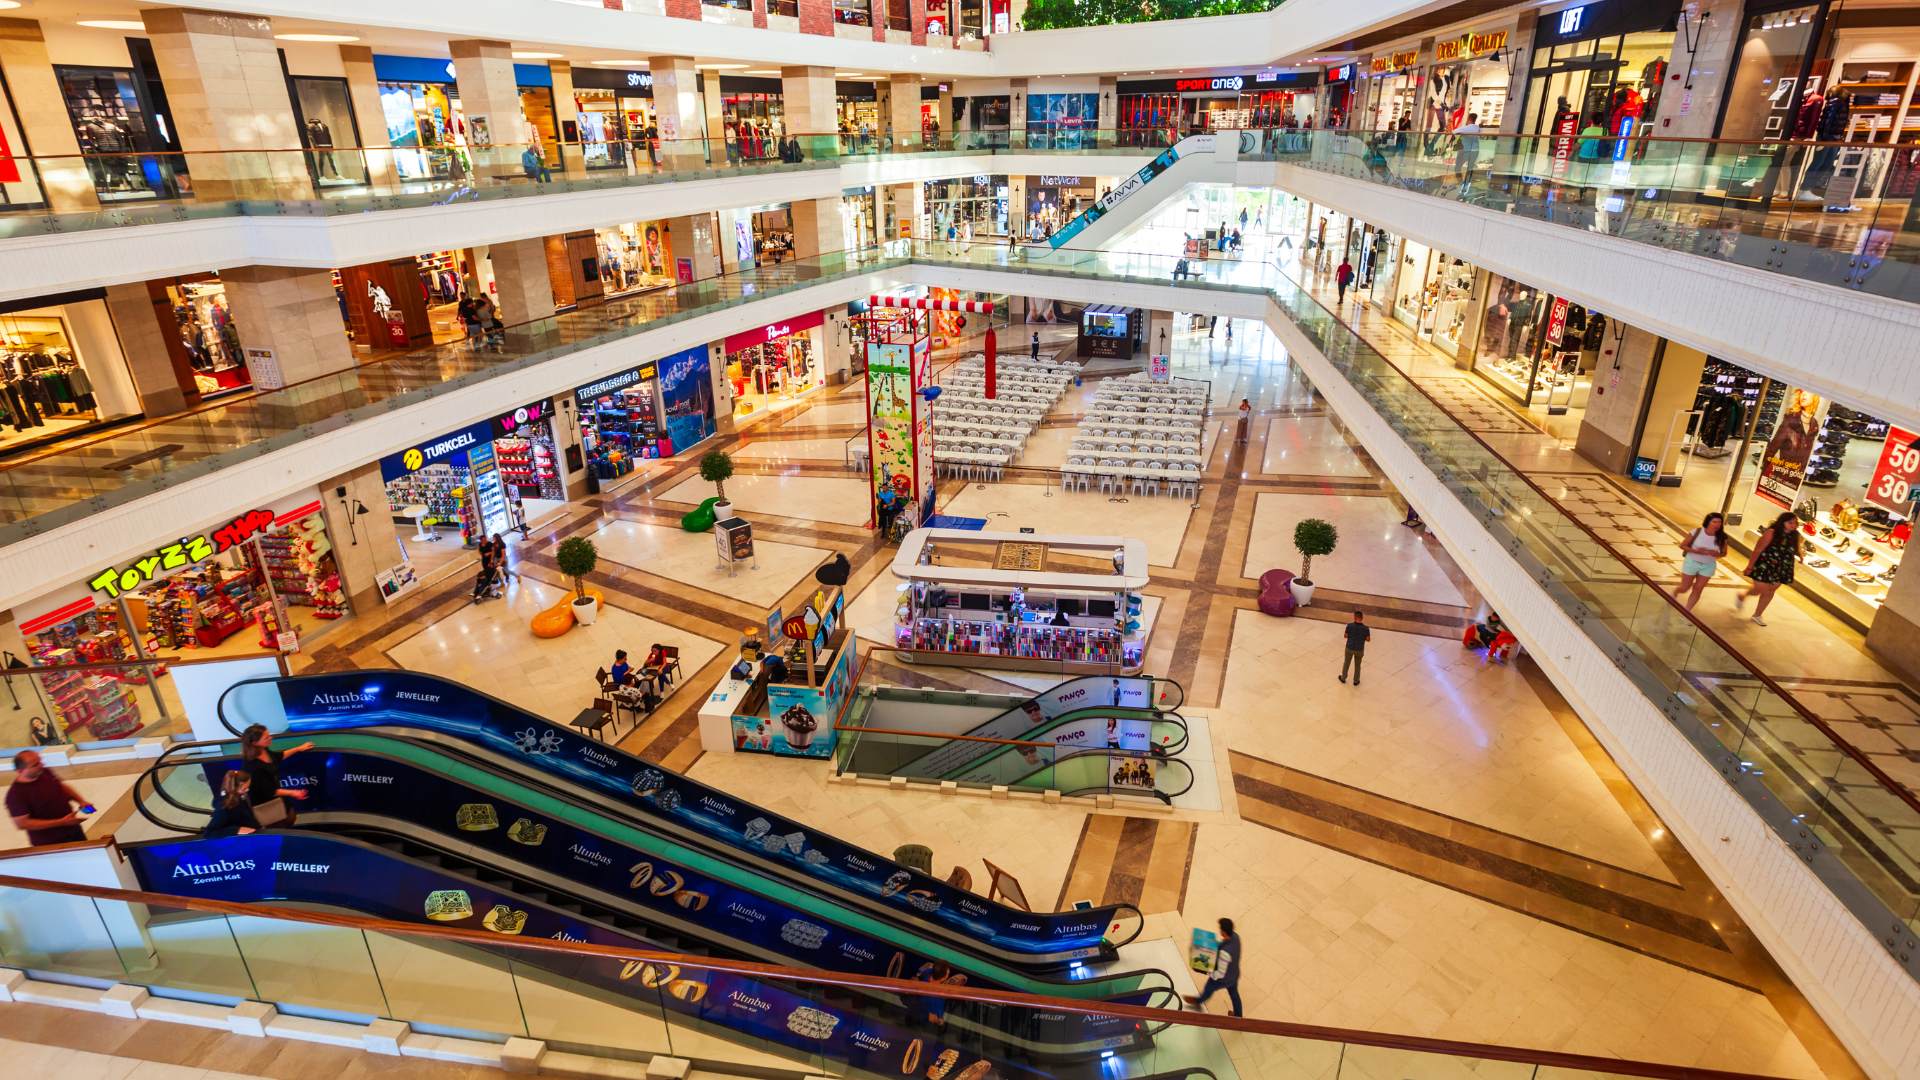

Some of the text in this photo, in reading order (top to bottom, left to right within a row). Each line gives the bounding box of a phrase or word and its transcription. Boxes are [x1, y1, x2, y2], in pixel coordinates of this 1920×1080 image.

[1559, 7, 1584, 34] LOFT
[1114, 179, 1139, 200] AVVA
[1554, 304, 1565, 321] 50
[392, 327, 404, 336] 30
[1550, 323, 1561, 339] 30
[424, 432, 476, 459] TURKCELL
[1889, 443, 1920, 473] 50
[1636, 463, 1656, 473] 300
[1878, 474, 1908, 504] 30
[212, 510, 274, 553] SHOP
[396, 691, 440, 703] JEWELLERY
[1058, 689, 1086, 703] PANÇO
[1056, 730, 1086, 743] PANÇO
[342, 773, 394, 784] JEWELLERY
[172, 859, 330, 878] Altınbaş JEWELLERY
[1010, 921, 1041, 932] JEWELLERY
[1032, 1012, 1066, 1021] JEWELLERY
